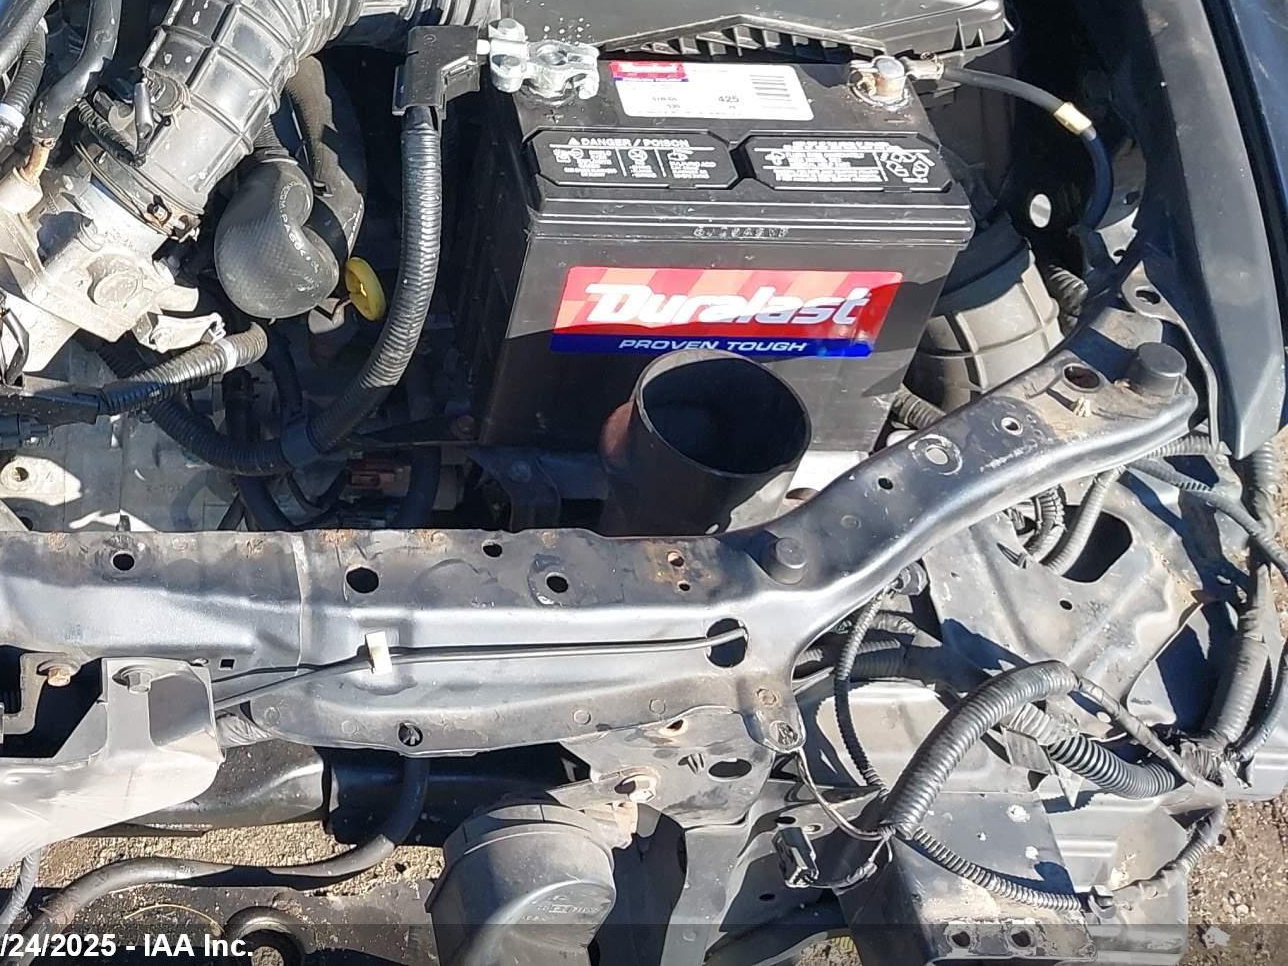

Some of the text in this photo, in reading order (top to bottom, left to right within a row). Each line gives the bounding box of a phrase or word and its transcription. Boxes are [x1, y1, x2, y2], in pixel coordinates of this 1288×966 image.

[581, 138, 632, 147] DANGER
[643, 138, 690, 148] POISON
[584, 282, 874, 325] Duralast
[618, 338, 808, 353] PROVEN TOUGH
